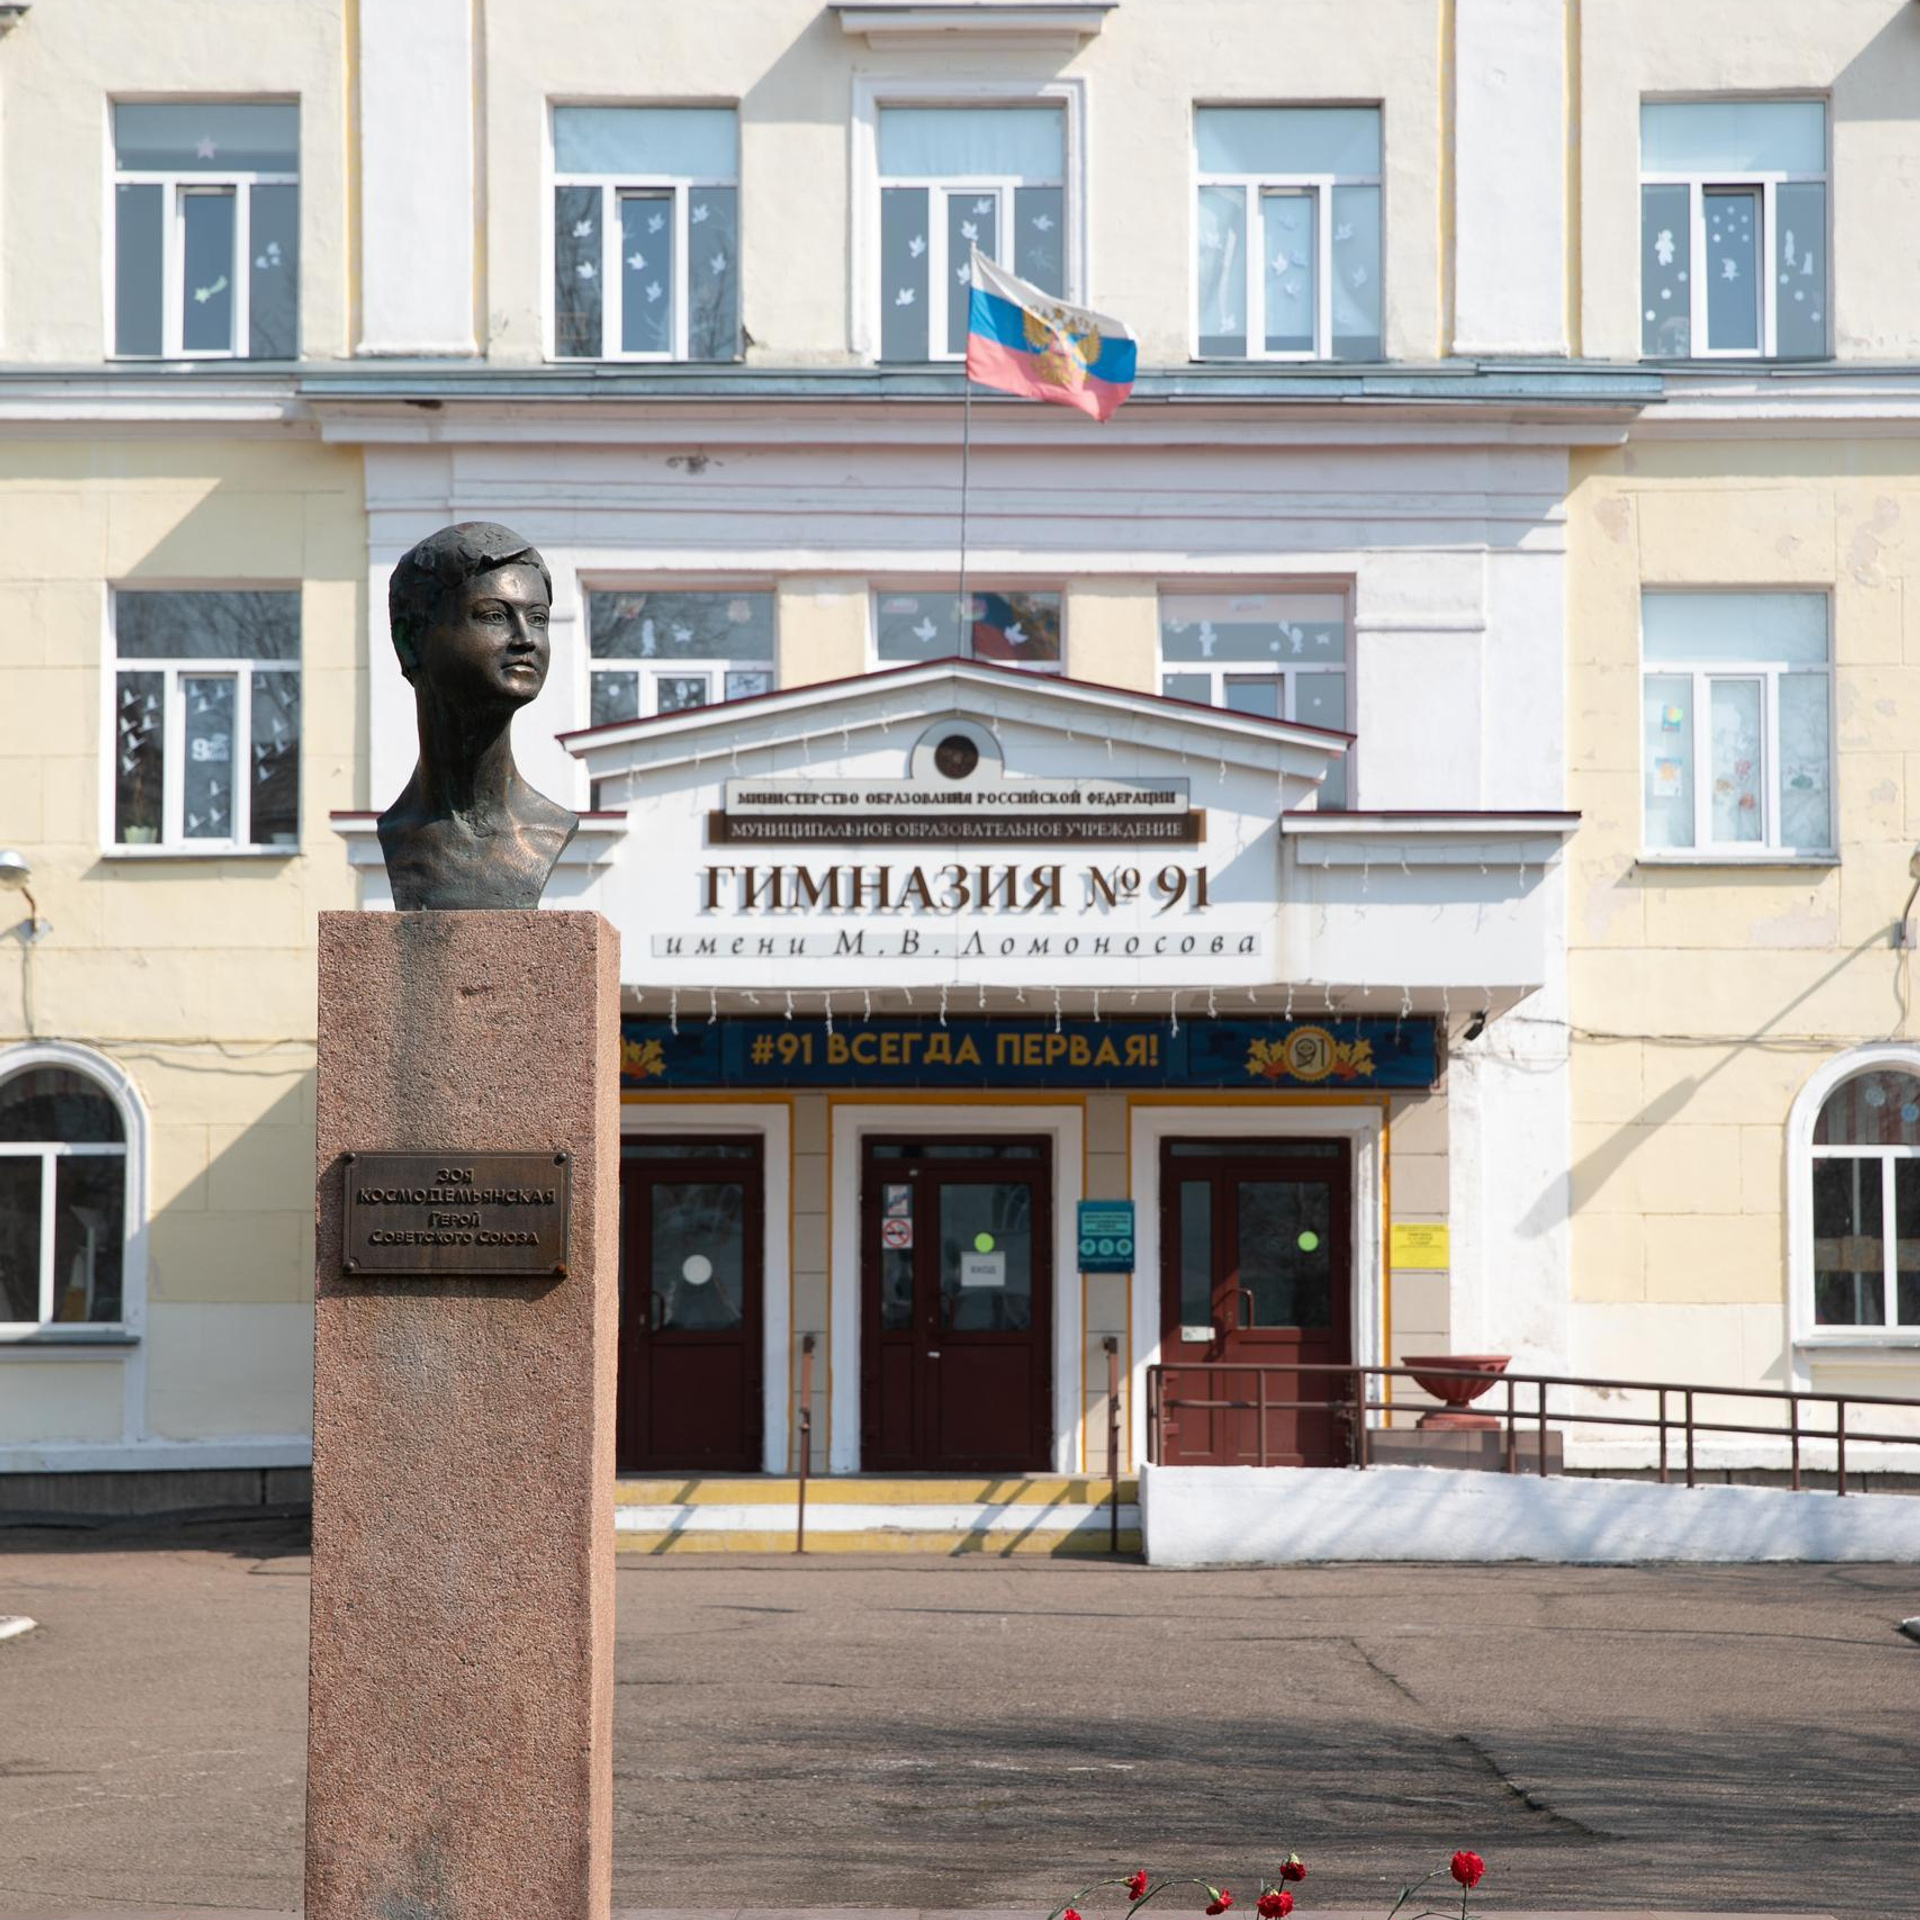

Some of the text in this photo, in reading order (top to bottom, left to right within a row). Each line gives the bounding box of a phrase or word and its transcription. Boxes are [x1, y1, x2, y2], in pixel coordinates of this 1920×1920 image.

[737, 790, 1176, 806] МИНИСТЕРСТВО ОБРАЗОВАНИЯ РОССИЙСКОЙ ФЕДЕРАЦИИ
[731, 821, 1182, 838] МУНИЦИПАЛЬНОЕ ОБРАЗОВАТЕЛЬНОЕ УЧРЕЖДЕНИЕ
[703, 864, 1065, 909] ГИМНАЗИЯ
[666, 935, 806, 955] имени
[960, 929, 1255, 956] Ломоносова
[751, 1032, 1159, 1066] #91 ВСЕГДА ПЕРВАЯ!
[437, 1168, 475, 1184] ЗОЯ
[358, 1187, 556, 1204] КОСМОДЕМЬЯНСКАЯ
[430, 1209, 481, 1227] ГЕРОЙ
[370, 1229, 540, 1245] СОВЕТСКОГО СОЮЗА
